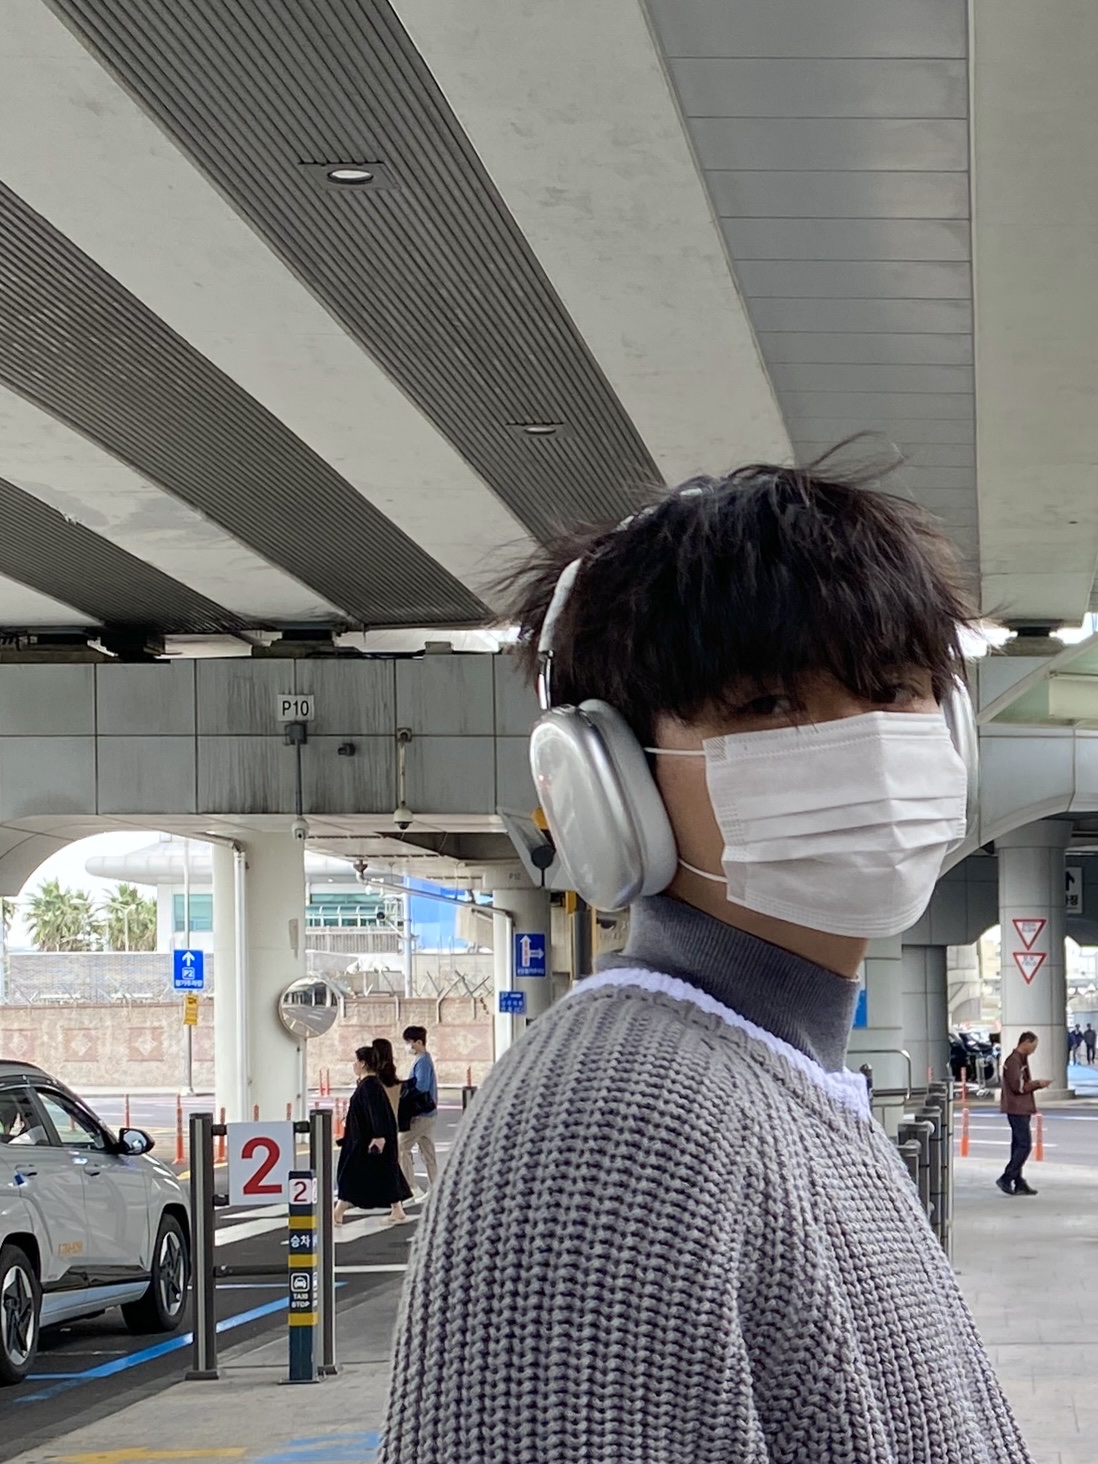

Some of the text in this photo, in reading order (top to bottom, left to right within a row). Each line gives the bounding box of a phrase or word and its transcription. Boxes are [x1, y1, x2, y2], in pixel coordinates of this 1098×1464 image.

[282, 700, 309, 717] P10
[241, 1136, 283, 1195] 2
[293, 1181, 307, 1203] 2
[290, 1234, 311, 1249] 승차
[291, 1301, 310, 1309] STOP
